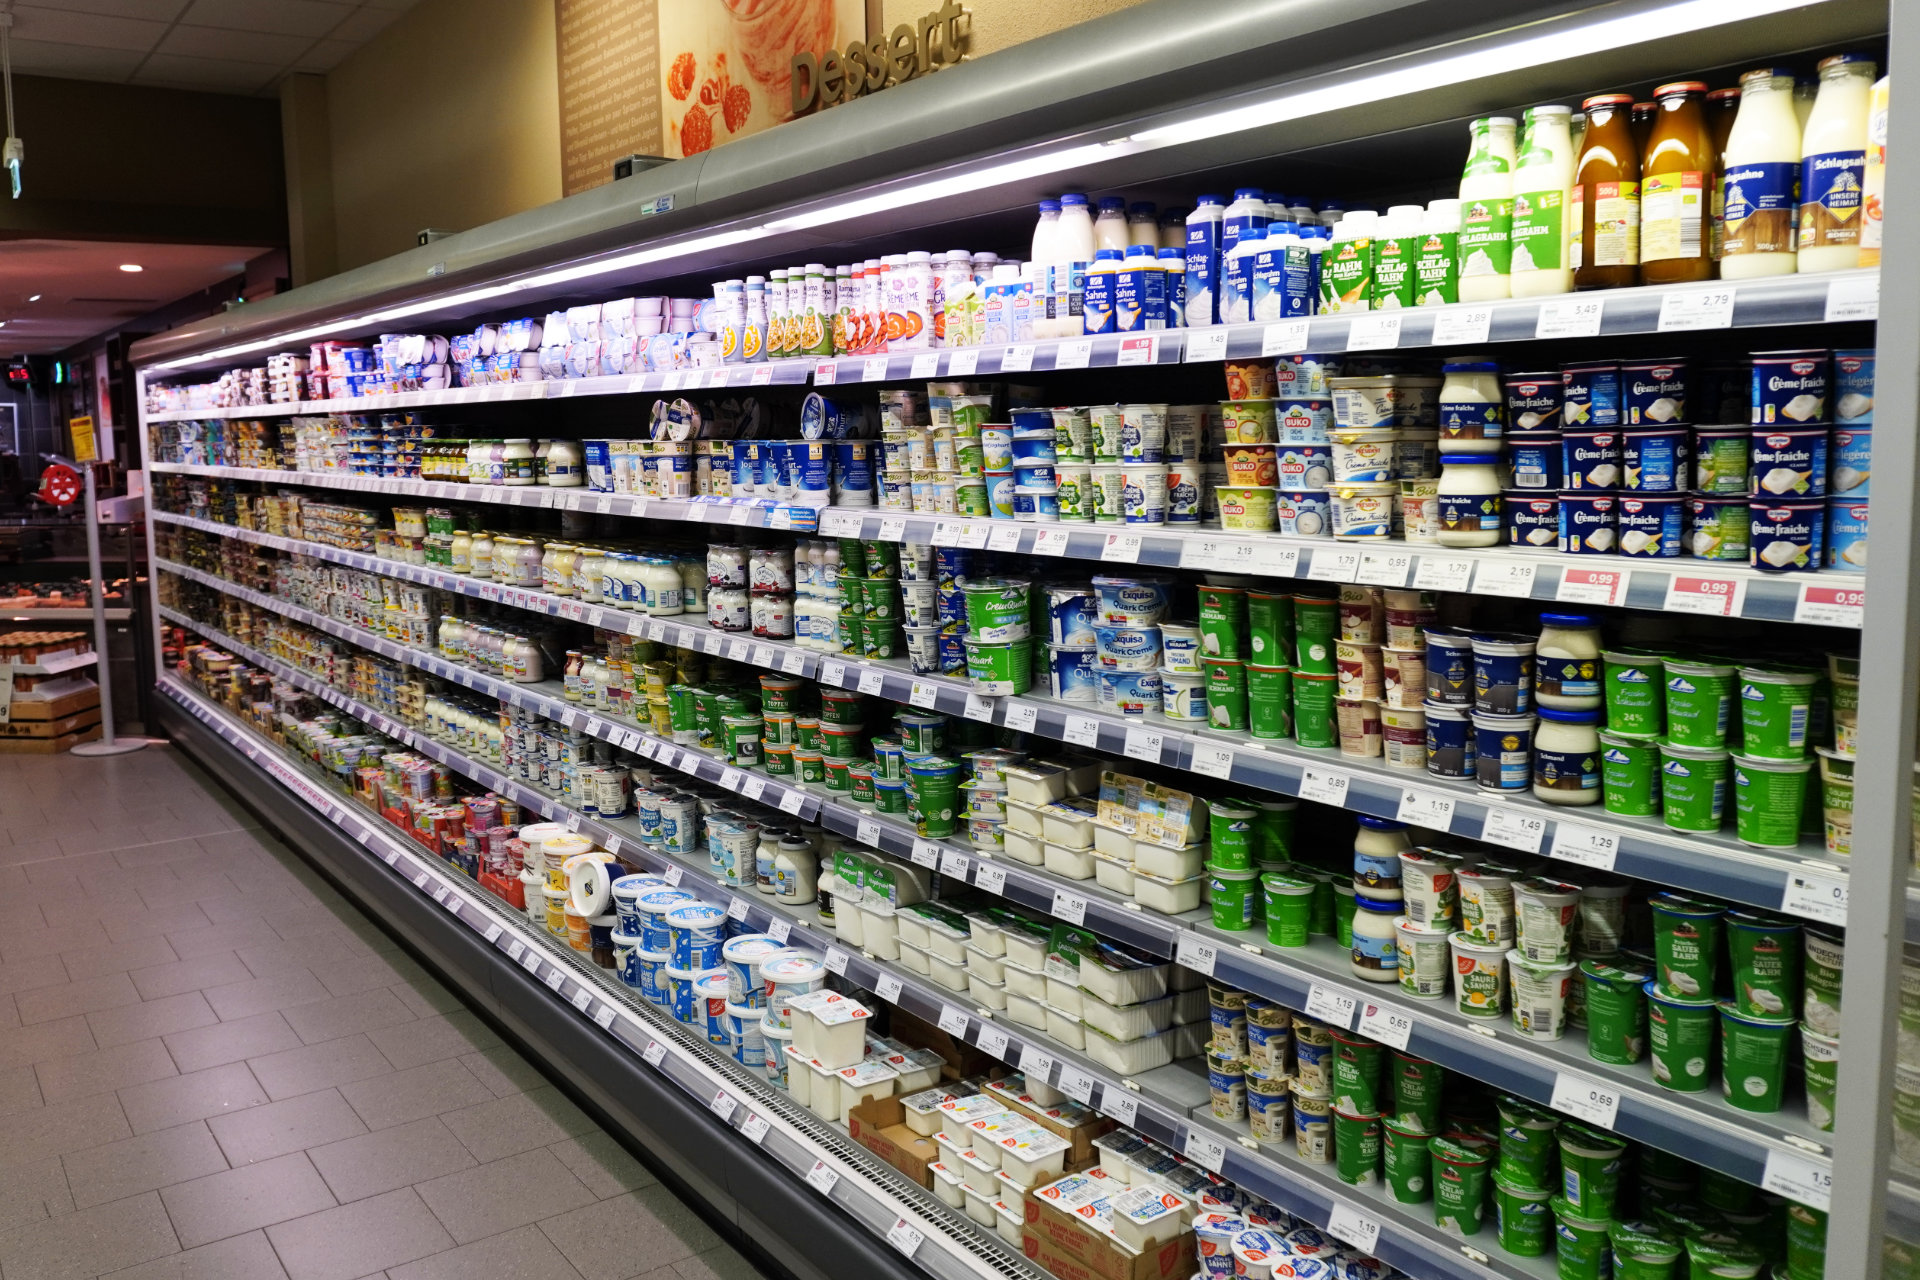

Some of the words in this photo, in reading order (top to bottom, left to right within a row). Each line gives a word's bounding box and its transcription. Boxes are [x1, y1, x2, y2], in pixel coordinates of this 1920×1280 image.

[791, 0, 962, 114] Dessert
[1829, 191, 1859, 200] UNSERE
[1829, 199, 1859, 208] HEIMAT
[1186, 254, 1208, 264] Schlag-
[1416, 258, 1451, 270] SCHLAG
[1188, 263, 1206, 272] Rahm
[1333, 260, 1362, 273] RAHM
[1375, 263, 1408, 274] SCHLAG
[1378, 272, 1404, 283] RAHM
[1419, 267, 1447, 278] RAHM
[1085, 290, 1107, 300] Sahne
[1115, 288, 1136, 299] Sahne
[1703, 295, 1729, 308] 2,79
[1575, 304, 1598, 316] 3,49
[1466, 313, 1487, 325] 2,89
[1210, 335, 1224, 344] 1,49
[1633, 381, 1659, 395] Crème
[1768, 376, 1800, 391] Crème
[1286, 418, 1309, 426] BUKO
[1575, 447, 1600, 460] Crème
[1233, 462, 1255, 470] BUKO
[1282, 464, 1303, 473] BUKO
[1416, 486, 1437, 497] Bio
[1224, 505, 1243, 514] BUKO
[1515, 512, 1538, 524] Crème
[1574, 510, 1600, 524] Crème
[1751, 520, 1775, 536] Crème
[1237, 546, 1252, 555] 2,19
[1280, 551, 1295, 560] 1,49
[1338, 556, 1355, 565] 1,79
[1388, 558, 1406, 568] 0,95
[1448, 563, 1467, 573] 1,79
[1510, 567, 1531, 577] 2,19
[1588, 573, 1613, 584] 0,99
[1700, 582, 1728, 594] 0,99
[1122, 590, 1154, 600] Exquisa
[1835, 592, 1864, 605] 0,99
[1113, 601, 1137, 611] Quark
[1104, 644, 1126, 655] Quark
[1127, 644, 1153, 655] Creme
[1338, 647, 1354, 657] Bio
[1167, 656, 1190, 665] SCHMAND
[1129, 689, 1153, 698] Quark
[1624, 712, 1643, 723] 24%
[1672, 723, 1690, 734] 24%
[1147, 737, 1160, 746] 1,49
[1216, 752, 1230, 762] 1,09
[1540, 752, 1565, 762] Schmand
[1328, 777, 1345, 788] 0,89
[1609, 792, 1625, 803] 24%
[1431, 800, 1450, 812] 1,19
[1668, 805, 1685, 817] 24%
[1520, 818, 1541, 831] 1,49
[1590, 835, 1612, 849] 1,29
[1071, 900, 1083, 910] 0,99
[1198, 947, 1213, 959] 0,89
[1672, 944, 1699, 953] SAUER
[1672, 951, 1699, 961] RAHM
[1753, 960, 1783, 969] SAUER
[1753, 967, 1781, 977] RAHM
[1819, 968, 1836, 979] Bio
[1470, 974, 1496, 984] SAURE
[1470, 982, 1496, 991] SAHNE
[1336, 997, 1353, 1009] 1,19
[1262, 1015, 1284, 1026] Bio
[1389, 1016, 1408, 1030] 0,65
[1038, 1058, 1050, 1069] 1,29
[1260, 1081, 1284, 1093] Bio
[1590, 1091, 1612, 1106] 0,69
[1300, 1100, 1325, 1112] Bio
[1207, 1143, 1221, 1156] 1,09
[826, 1171, 837, 1183] 0,95
[1812, 1171, 1831, 1188] 1,5
[1438, 1182, 1464, 1196] SCHLAG
[1440, 1189, 1461, 1201] RAHM
[1359, 1219, 1376, 1234] 1,19
[909, 1231, 921, 1244] 0,70
[1208, 1260, 1233, 1269] SAHNE
